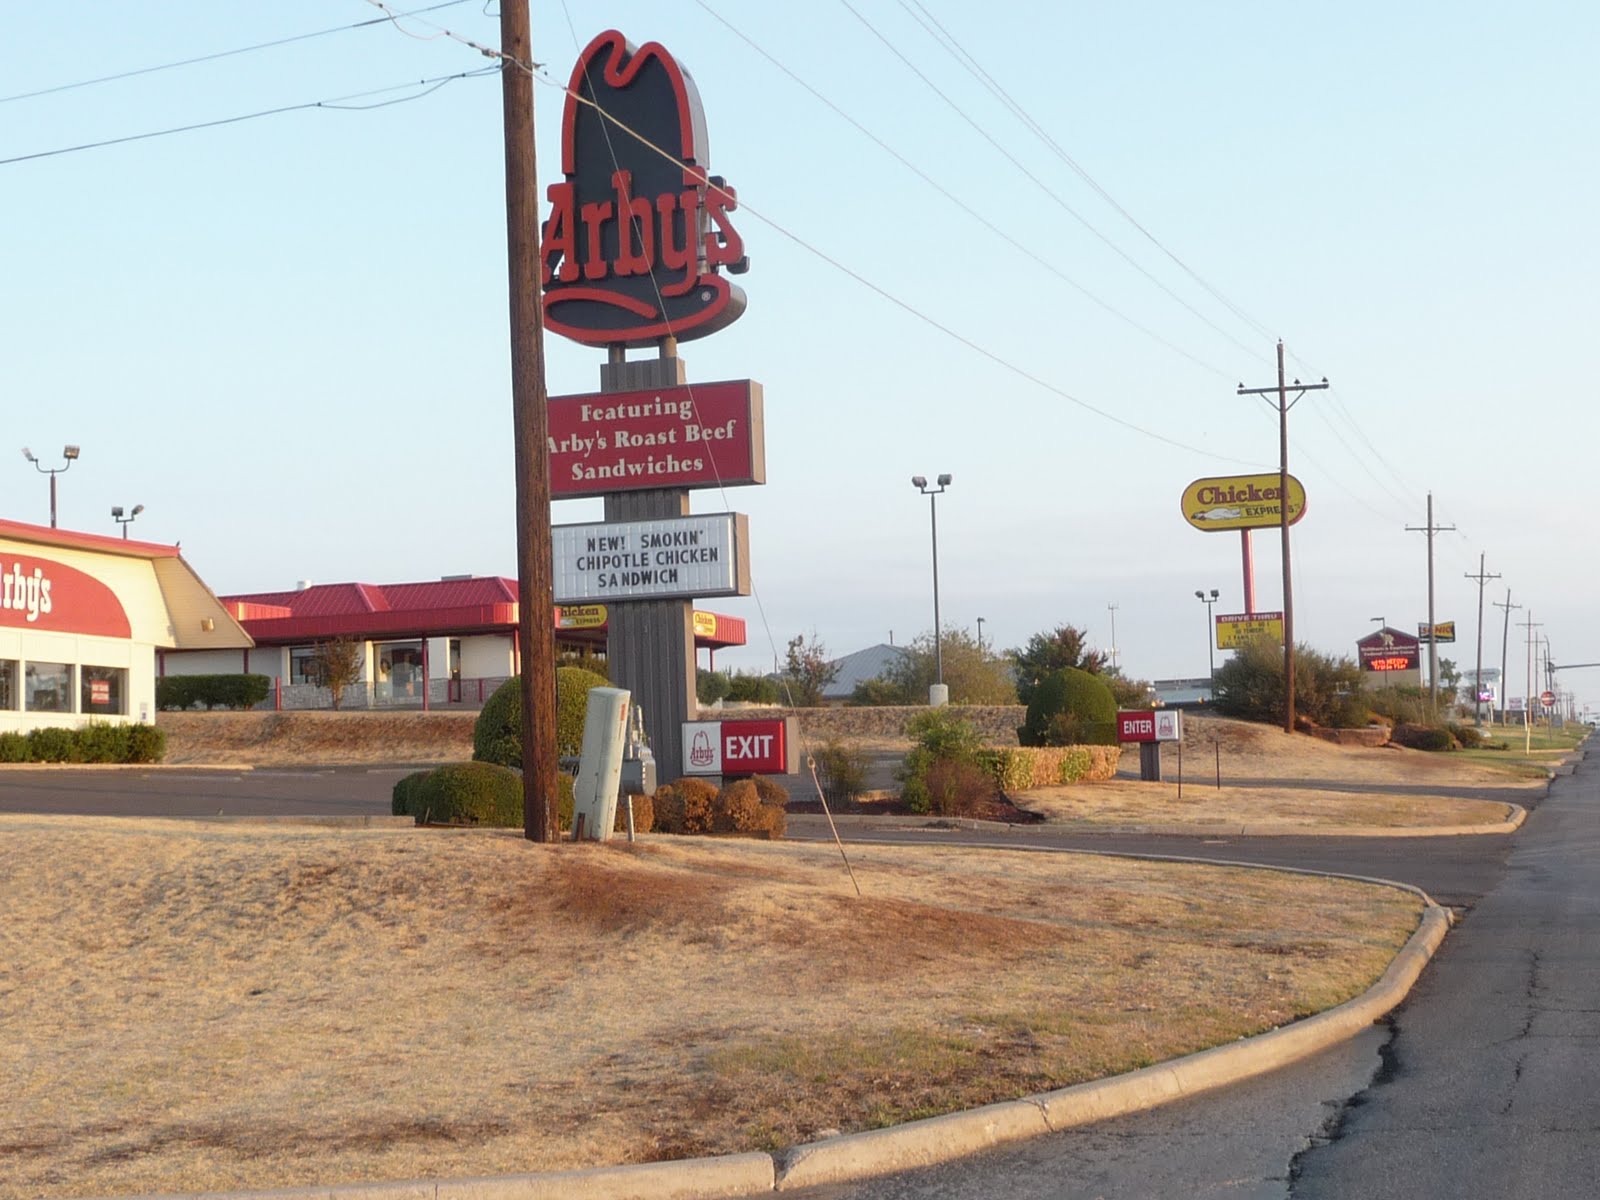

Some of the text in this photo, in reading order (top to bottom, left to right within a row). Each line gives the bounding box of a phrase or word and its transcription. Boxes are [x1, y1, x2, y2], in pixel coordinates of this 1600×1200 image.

[540, 165, 745, 297] Arby's
[580, 396, 693, 422] Featuring
[547, 419, 737, 457] Arby's Roast Beef
[572, 454, 704, 481] Sandwiches
[1246, 505, 1294, 516] EXPRES
[587, 530, 704, 552] NEW! SMOKIN'
[577, 547, 718, 571] CHIPOTLE CHICKEN
[598, 569, 678, 588] SANDWICH
[0, 562, 52, 622] rby's
[560, 605, 599, 617] hicken
[1221, 613, 1277, 622] DRIVE THRU
[1422, 625, 1452, 634] SNIC
[1123, 720, 1152, 734] ENTER
[690, 745, 714, 760] Arby's
[726, 735, 774, 759] EXIT
